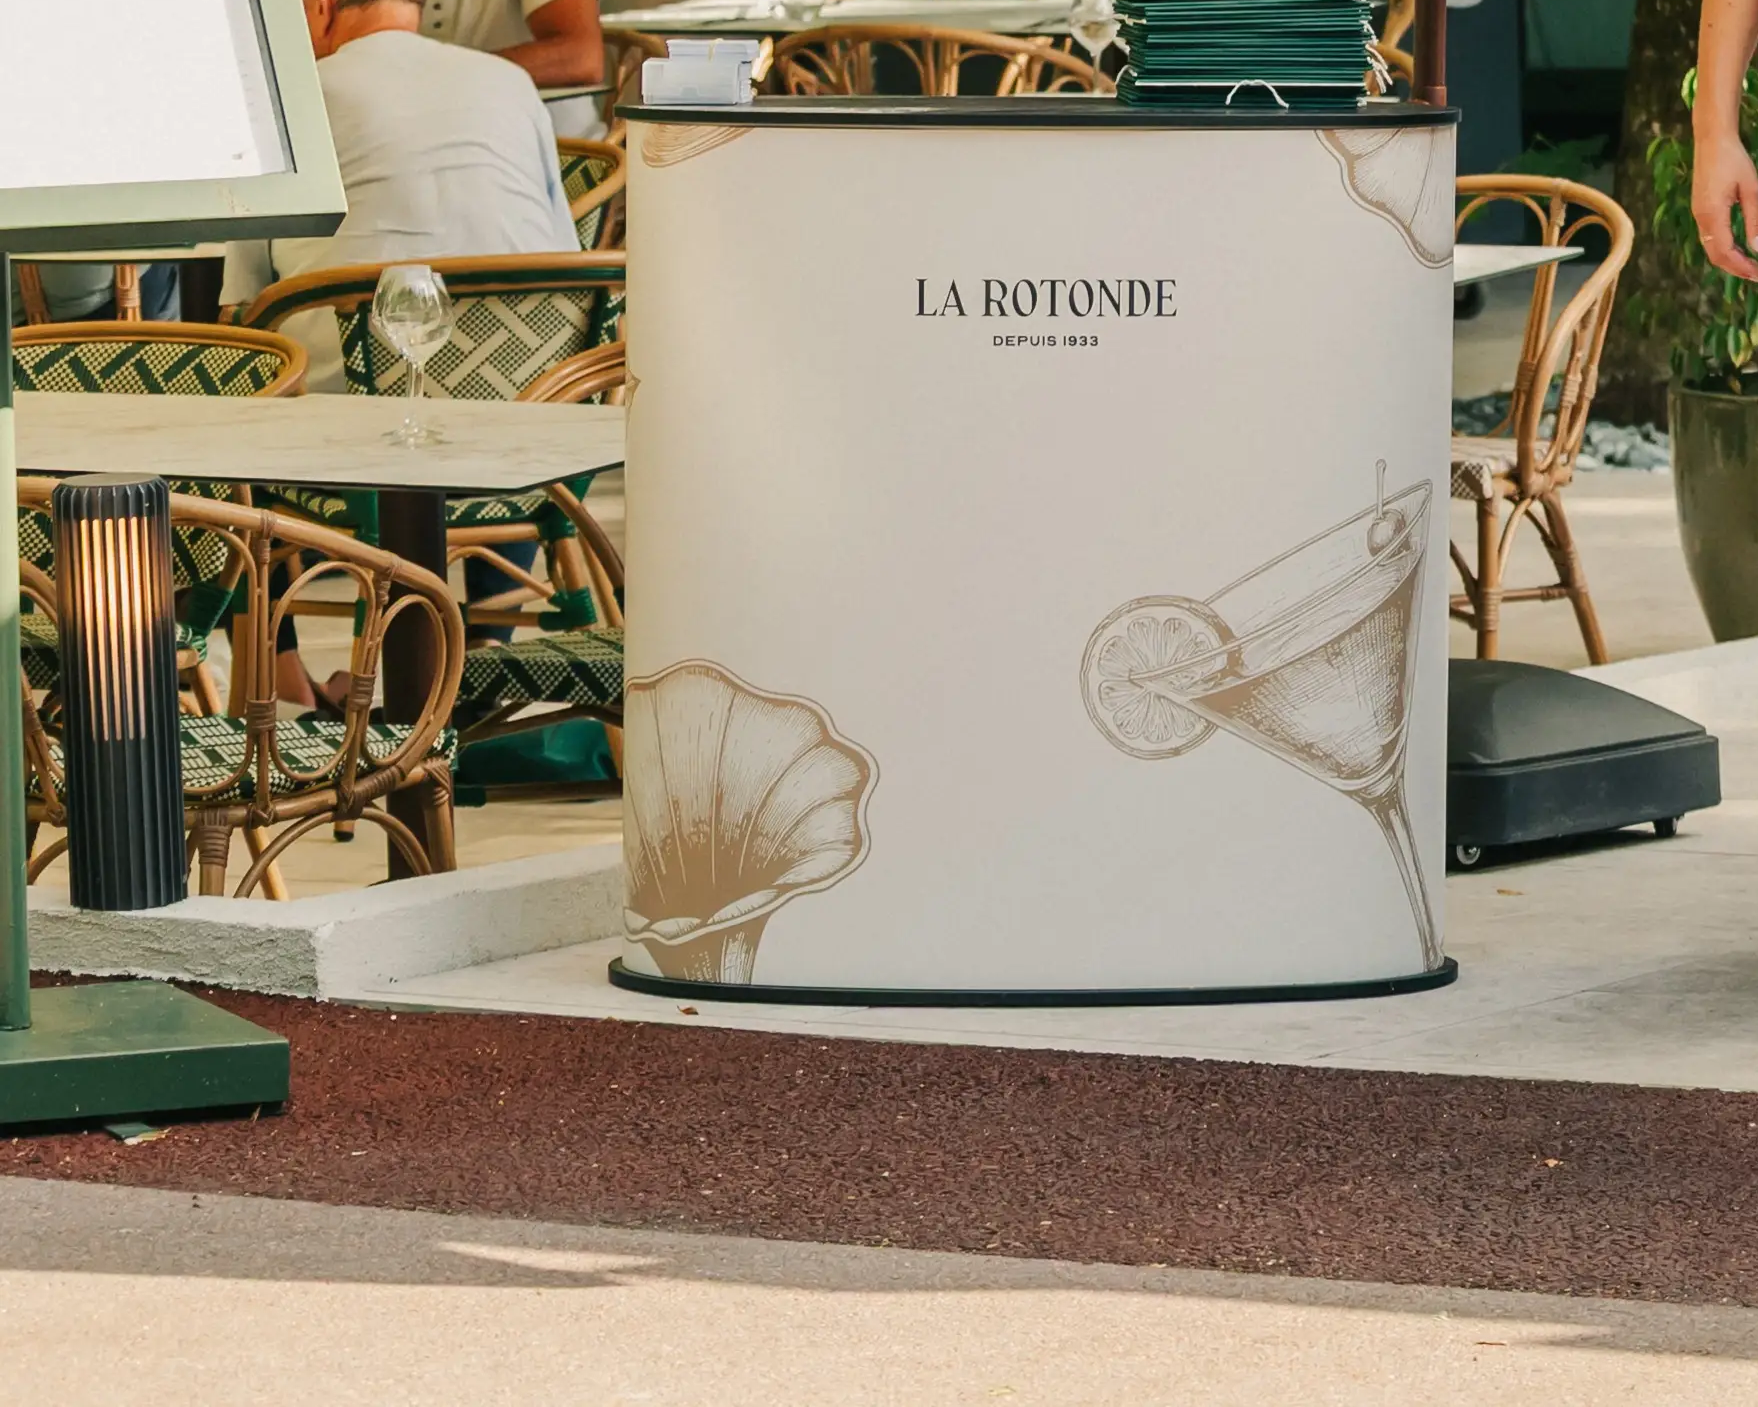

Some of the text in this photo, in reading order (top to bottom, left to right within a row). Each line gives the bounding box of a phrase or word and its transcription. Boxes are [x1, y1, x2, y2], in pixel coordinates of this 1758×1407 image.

[915, 278, 1177, 318] LA ROTONDE
[993, 335, 1099, 347] DEPUIS 1933
